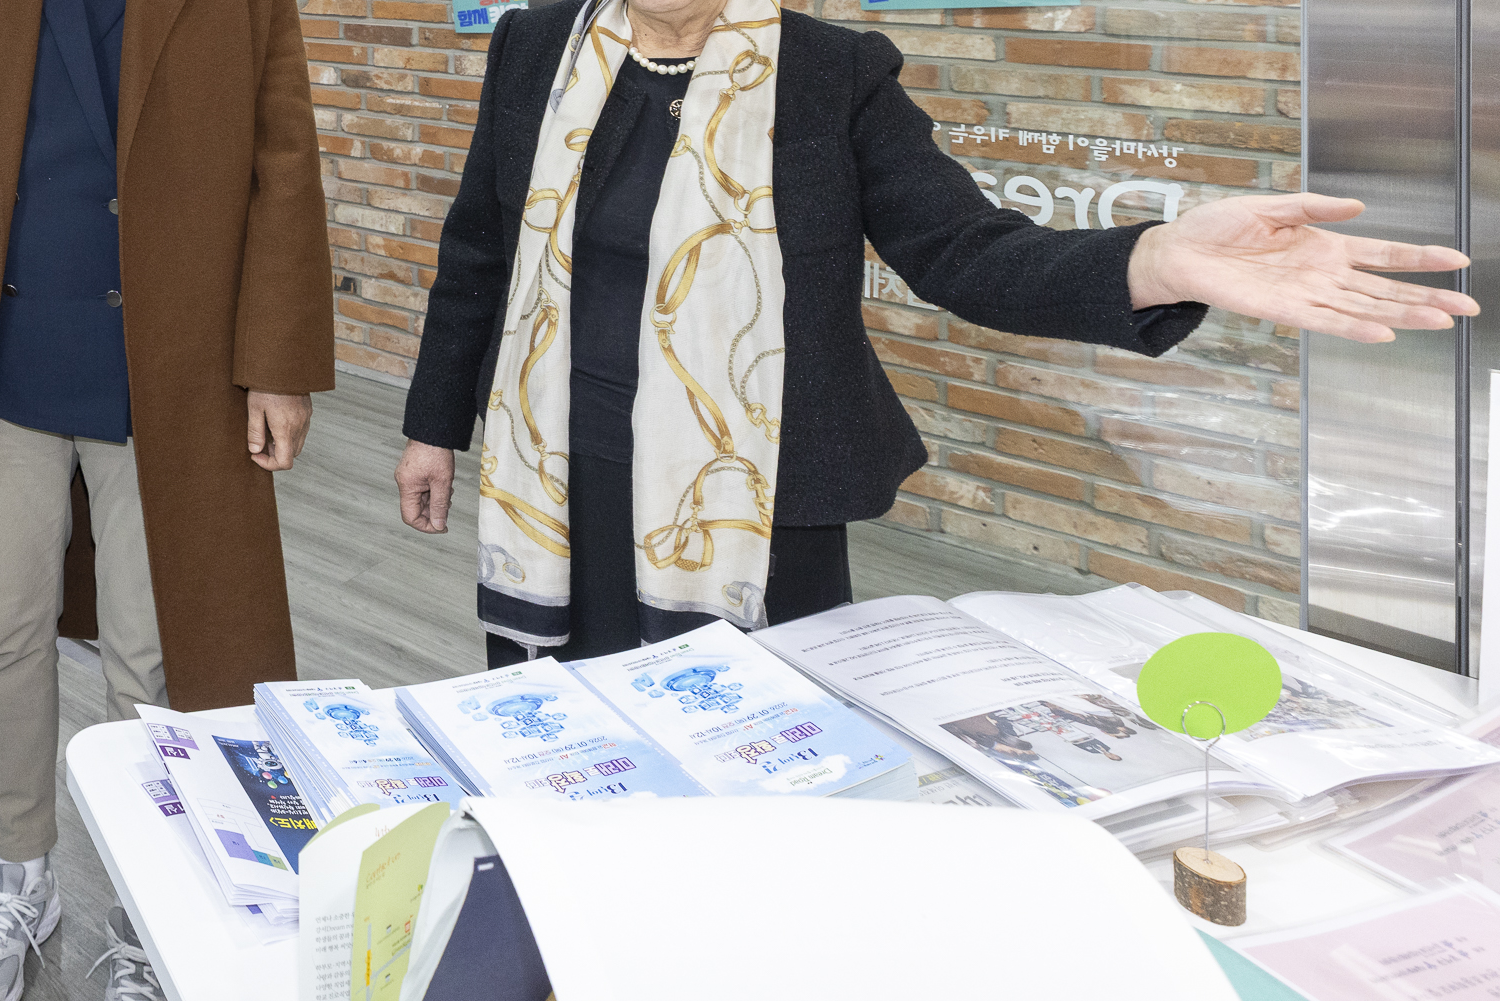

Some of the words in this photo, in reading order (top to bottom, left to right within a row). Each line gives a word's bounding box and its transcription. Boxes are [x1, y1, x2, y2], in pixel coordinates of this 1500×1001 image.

[458, 8, 489, 27] 함께
[769, 722, 823, 744] 미래로
[583, 757, 636, 776] 미래로
[808, 767, 834, 781] Dream
[790, 776, 810, 787] Road
